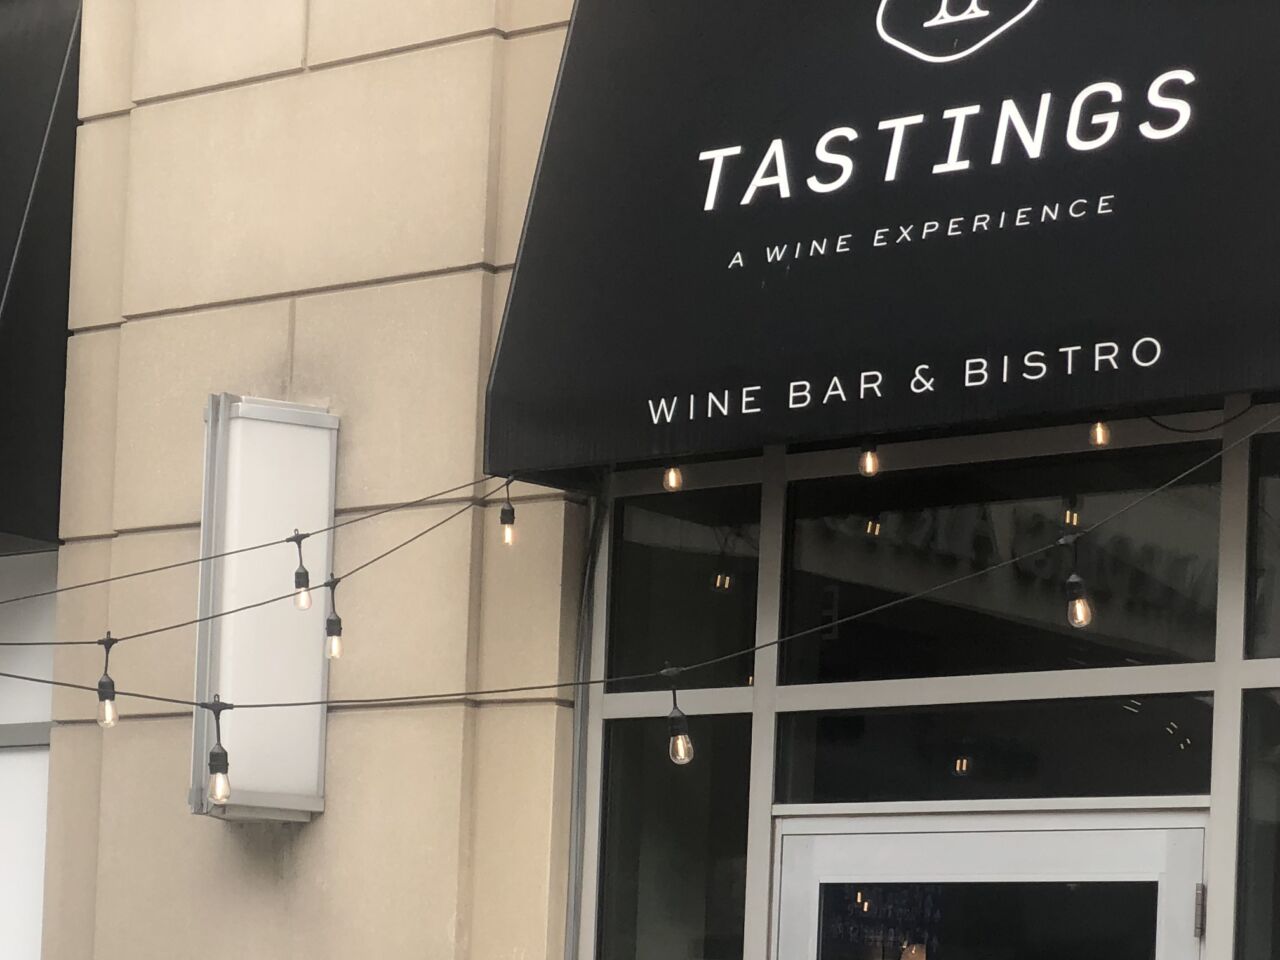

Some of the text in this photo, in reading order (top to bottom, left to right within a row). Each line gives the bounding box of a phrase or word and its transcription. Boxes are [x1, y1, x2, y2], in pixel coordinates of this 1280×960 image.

[698, 68, 1197, 212] TASTINGS
[727, 194, 1116, 269] A WINE EXPERIENCE
[648, 336, 1163, 425] WINE BAR & BISTRO
